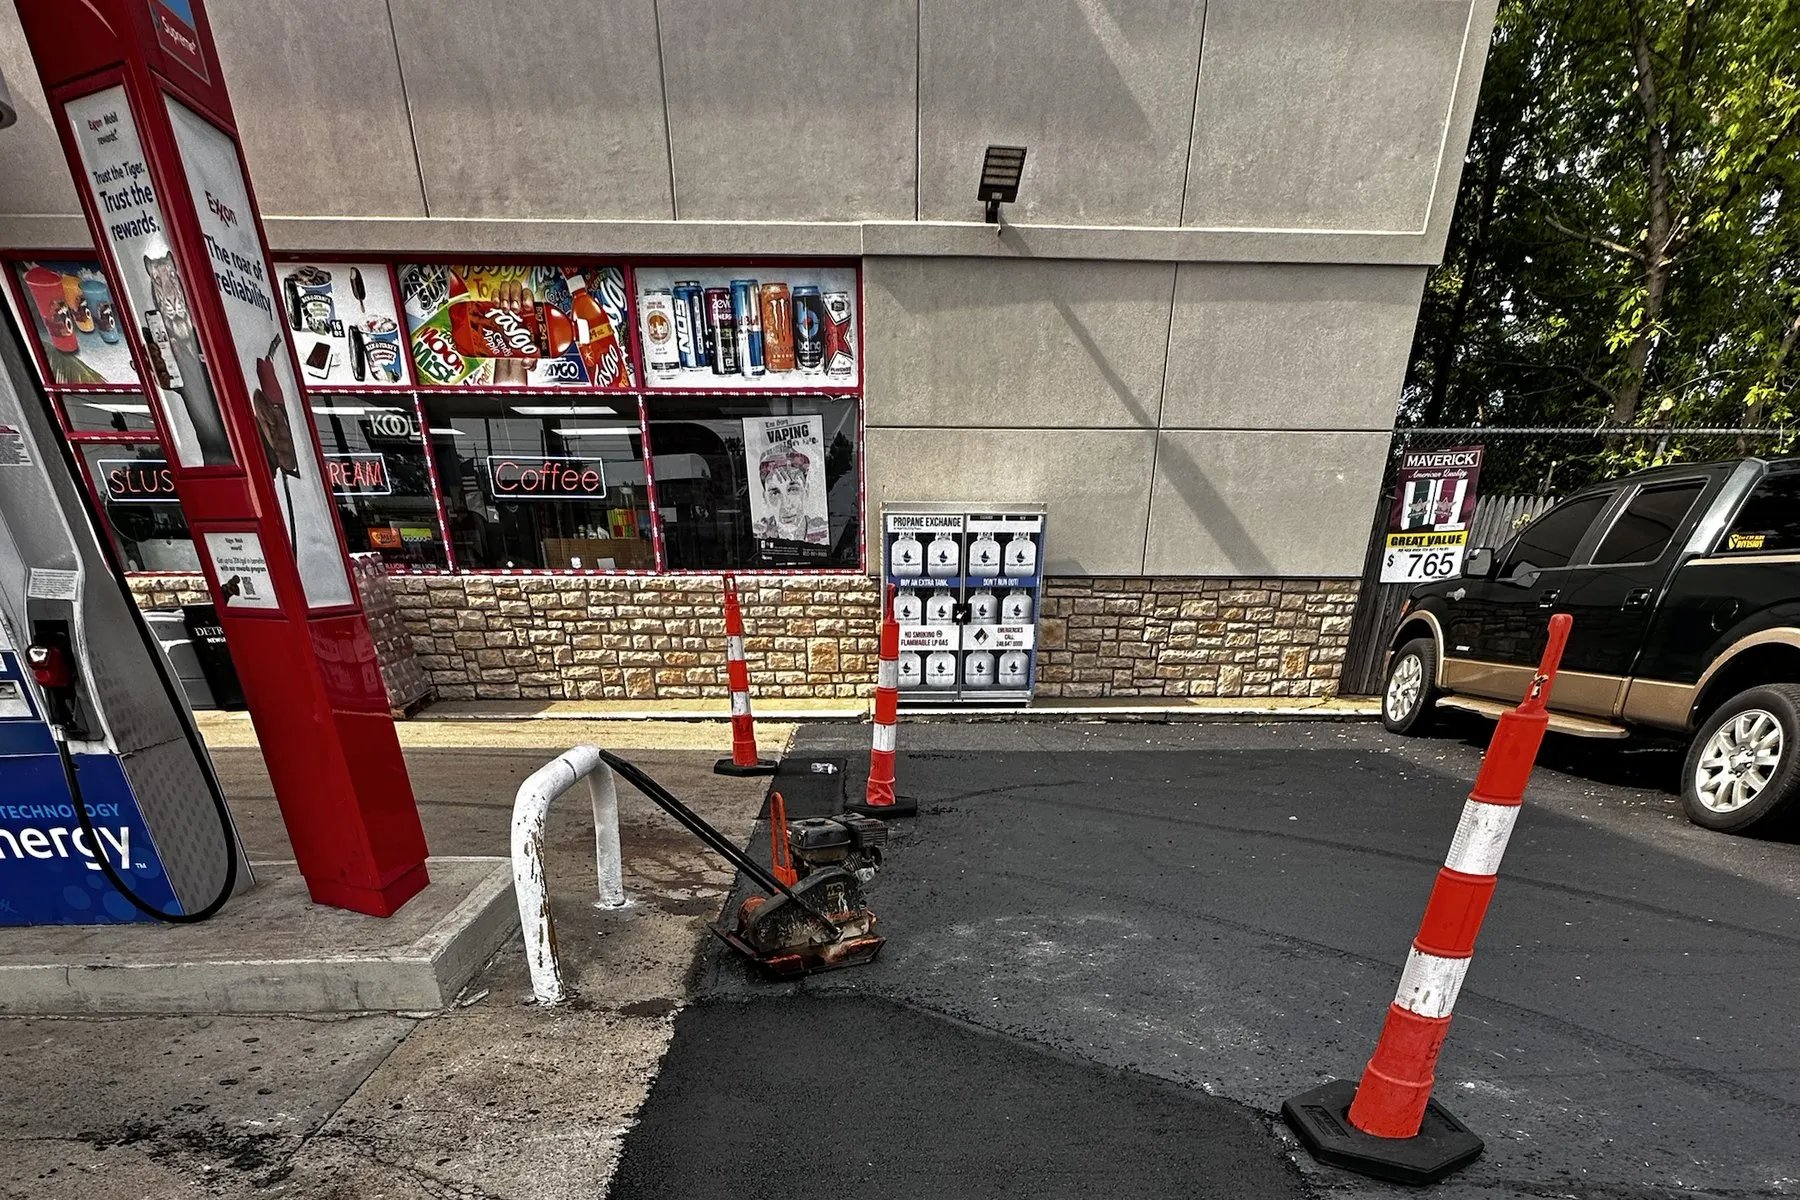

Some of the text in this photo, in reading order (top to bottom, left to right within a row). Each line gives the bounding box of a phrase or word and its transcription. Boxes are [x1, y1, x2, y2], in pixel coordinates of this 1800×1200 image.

[92, 161, 145, 184] Trust the Tiger.
[100, 181, 154, 213] Trust the
[205, 190, 238, 228] Exxon
[111, 210, 160, 242] rewards.
[204, 233, 264, 282] The roar of
[215, 269, 273, 320] reliability
[677, 298, 691, 354] NOS
[416, 326, 464, 374] Moon
[482, 328, 500, 354] Apple
[493, 332, 513, 357] Candy
[414, 341, 456, 383] Mist
[544, 361, 579, 378] AYGO
[370, 414, 421, 436] KOOL
[766, 424, 810, 444] VAPING
[1406, 454, 1475, 466] MAVERICK
[110, 469, 174, 494] SLUS
[328, 462, 384, 486] REAM
[495, 462, 600, 492] Coffee
[1408, 469, 1468, 478] American Quality
[894, 516, 961, 527] PROPANE EXCHANGE
[1390, 534, 1462, 546] GREAT VALUE
[1387, 552, 1455, 579] $ 7.65
[0, 803, 120, 819] TECHNOOGY
